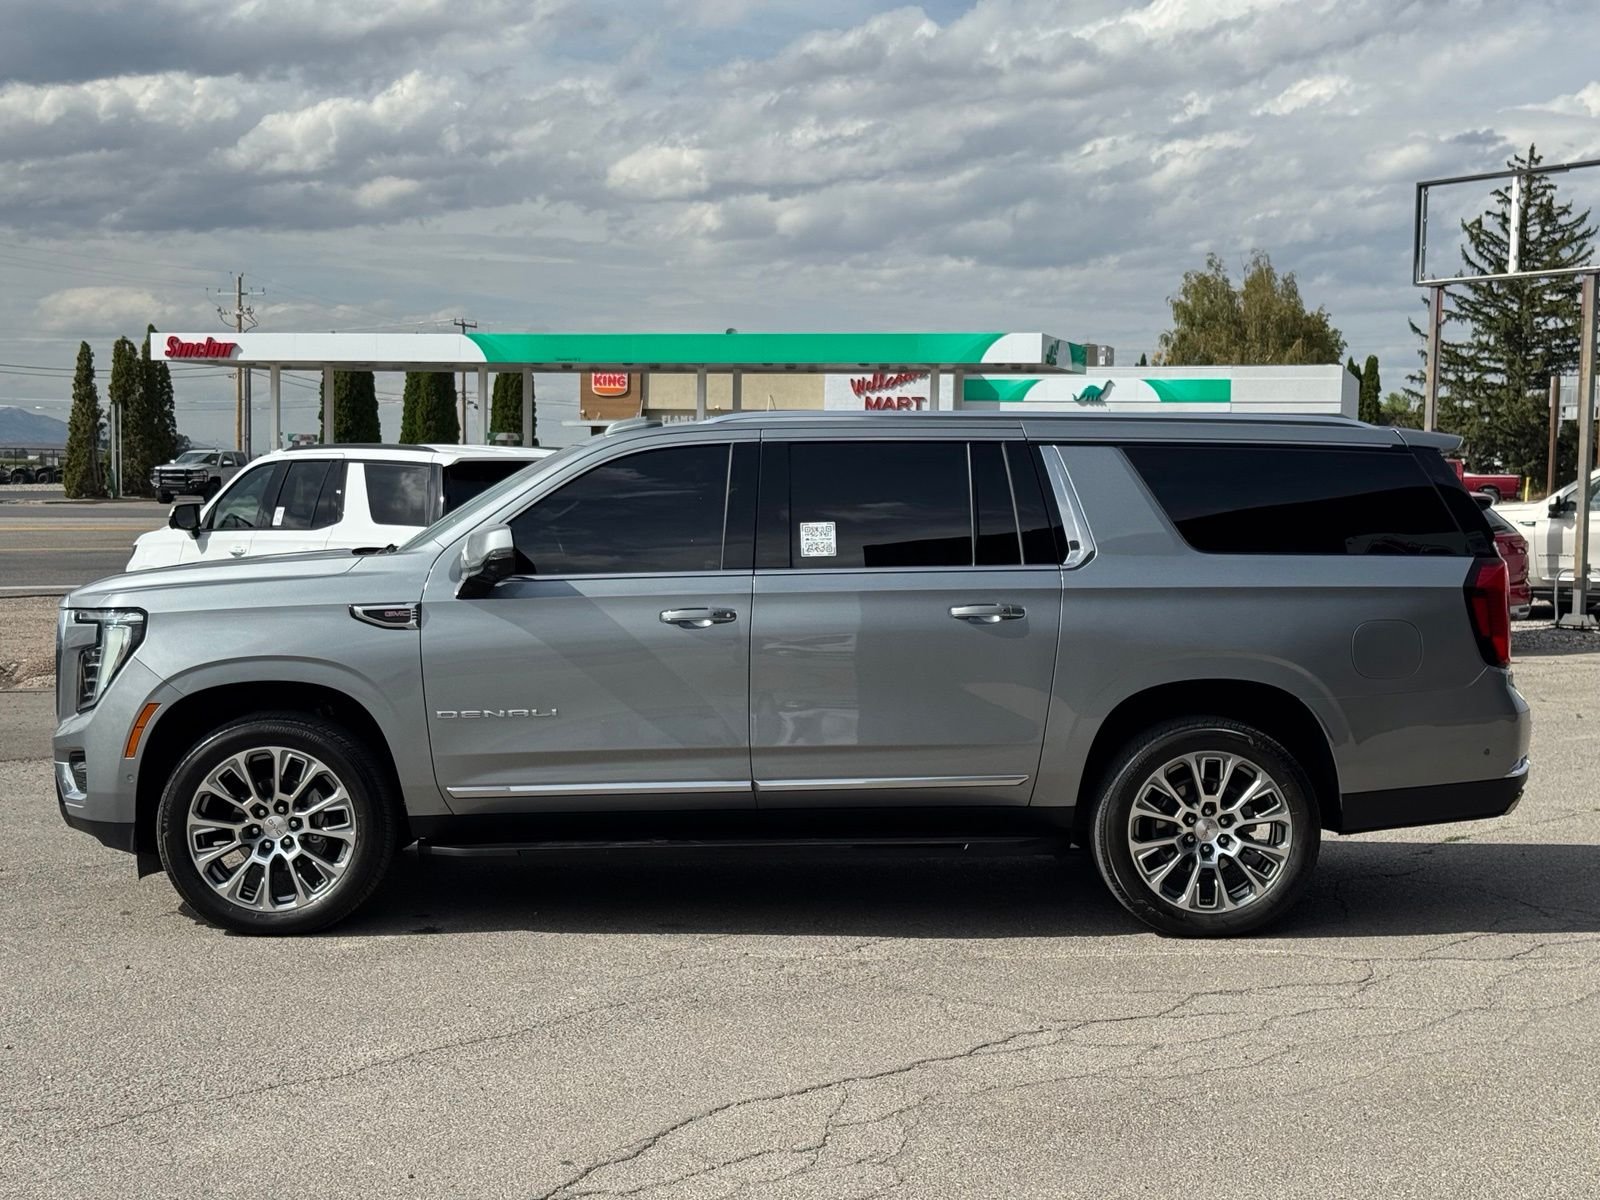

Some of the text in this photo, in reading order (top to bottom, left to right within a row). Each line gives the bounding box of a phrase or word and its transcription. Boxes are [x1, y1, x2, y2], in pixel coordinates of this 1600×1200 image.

[164, 336, 237, 358] Sinclair
[593, 375, 627, 387] KING
[865, 396, 927, 411] MART
[436, 708, 557, 719] DENALI
